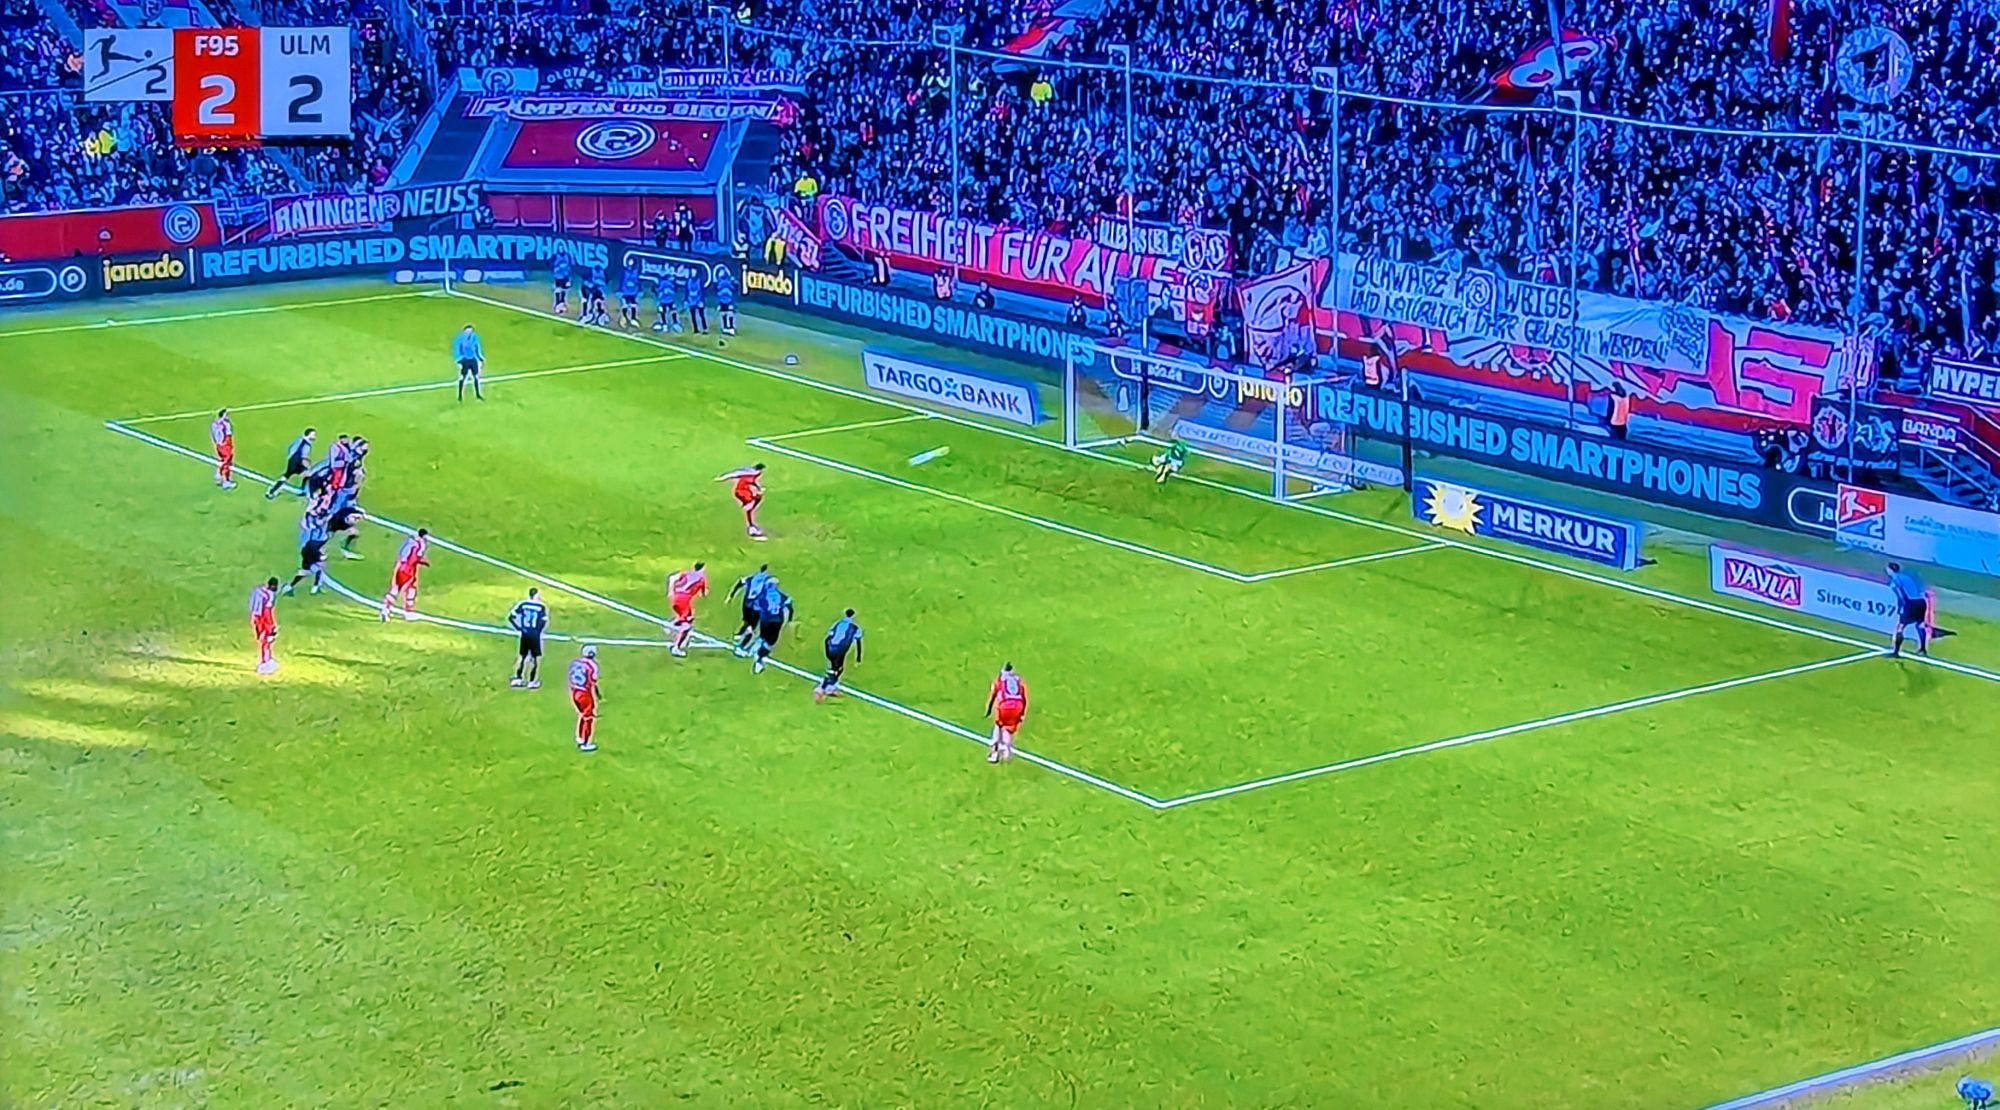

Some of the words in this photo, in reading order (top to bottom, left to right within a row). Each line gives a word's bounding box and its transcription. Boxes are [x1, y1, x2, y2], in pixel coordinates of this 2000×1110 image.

[273, 194, 388, 233] RATINGEN
[401, 183, 480, 218] NEUSS
[203, 237, 405, 278] REFURBISHED
[408, 233, 608, 269] SMARTPHONES
[851, 202, 995, 270] FREIHEIT
[1002, 230, 1071, 283] FÜR
[103, 253, 184, 291] janado
[742, 263, 793, 297] janado
[802, 276, 932, 331] REFURBISHED
[933, 303, 1097, 368] SMARTPHONES
[1318, 387, 1507, 457] REFURBISHED
[1510, 431, 1762, 510] SMARTPHONES
[1492, 502, 1616, 555] MERKUR
[1729, 560, 1798, 601] YAYLA
[1816, 588, 1862, 614] Since
[1866, 599, 1899, 619] 197
